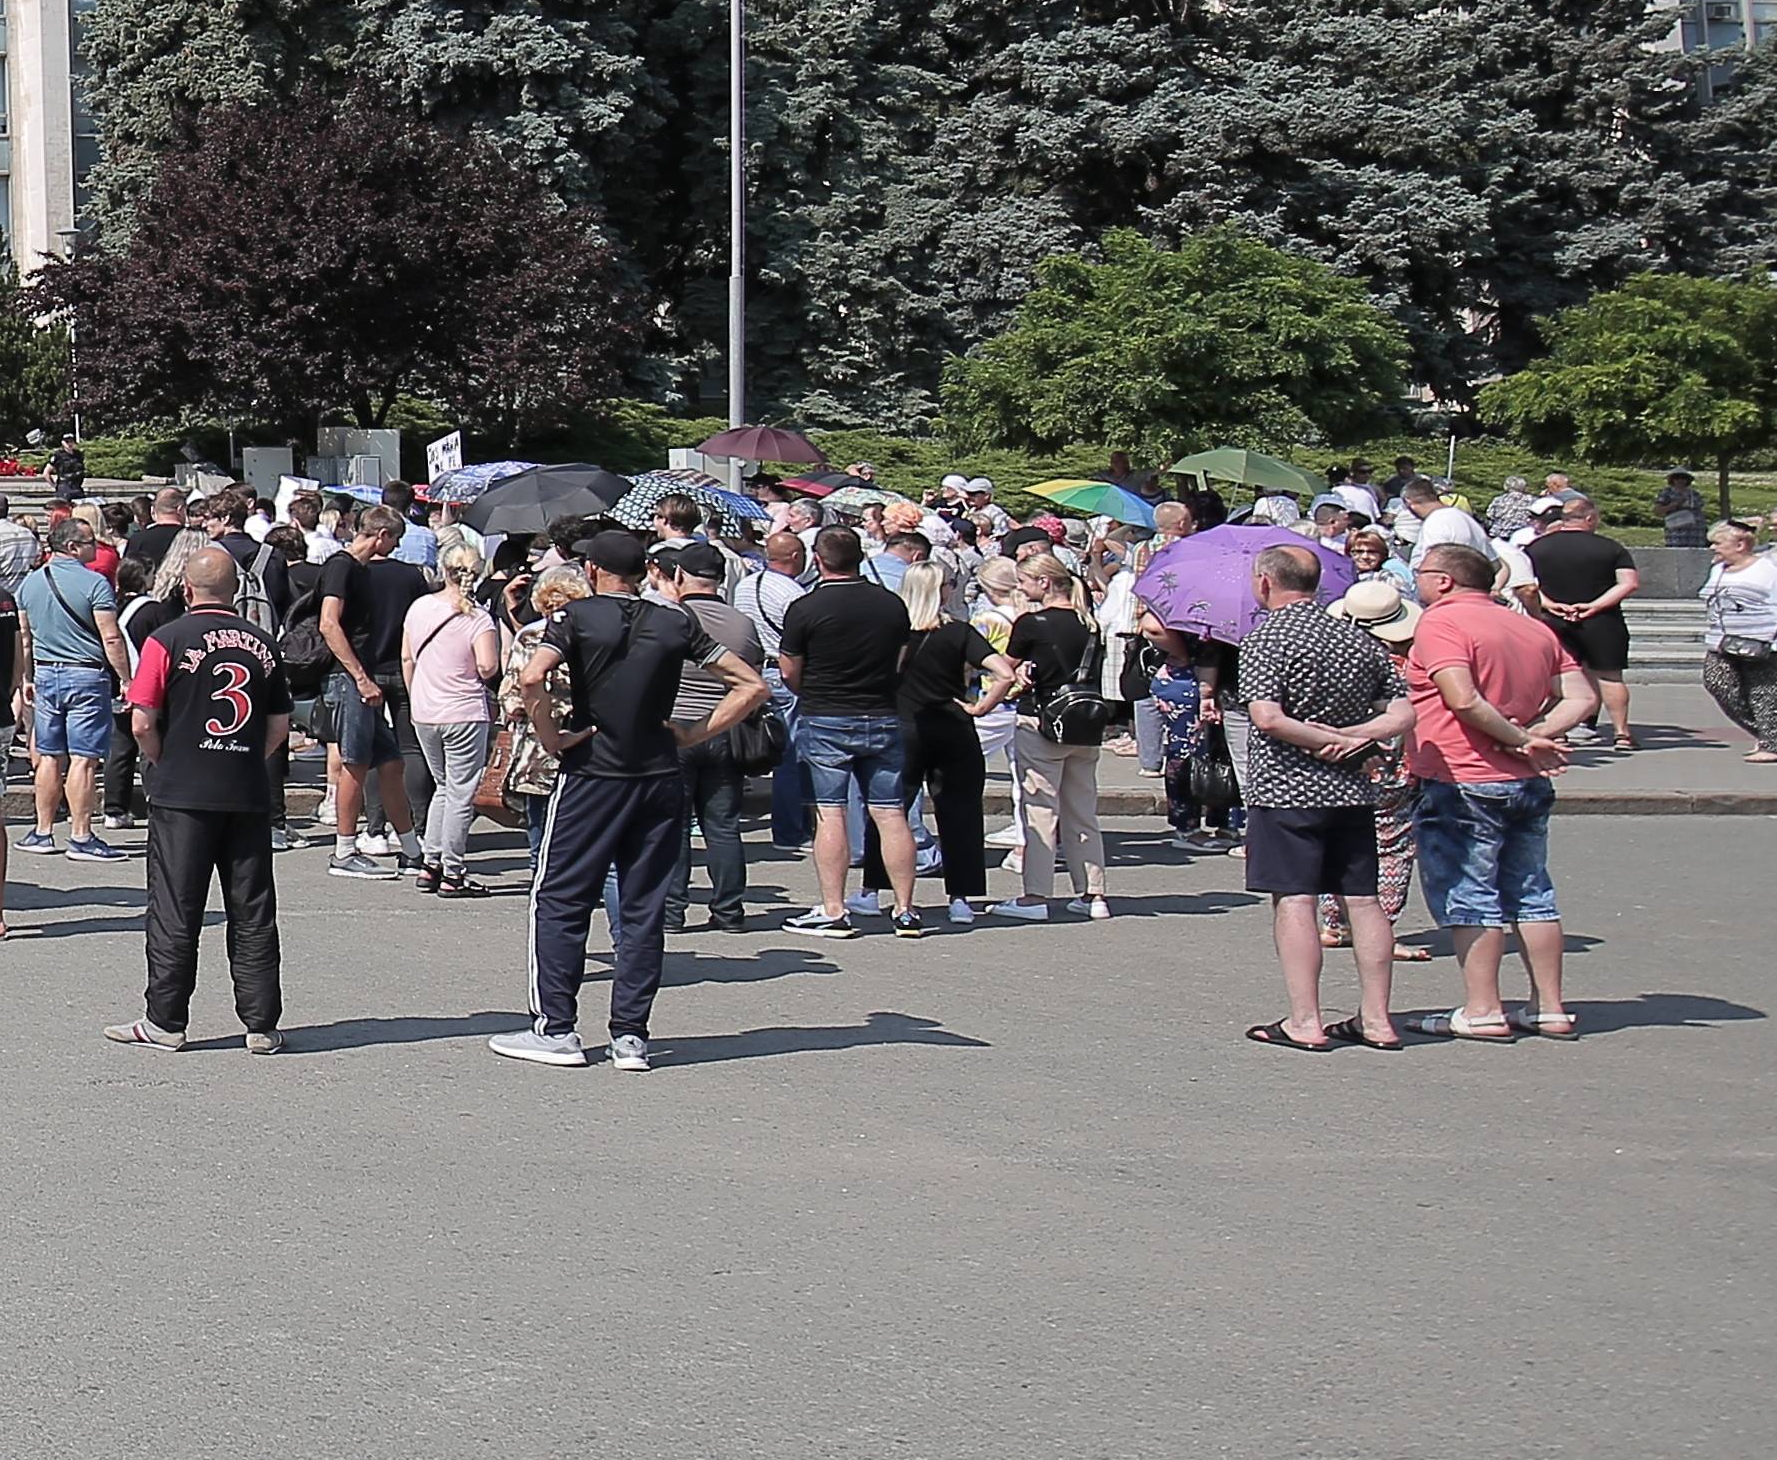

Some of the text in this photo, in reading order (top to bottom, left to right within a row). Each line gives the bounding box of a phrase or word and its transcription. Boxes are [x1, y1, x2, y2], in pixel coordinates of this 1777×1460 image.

[178, 629, 276, 678] LA MARTINA
[205, 662, 252, 736] 3
